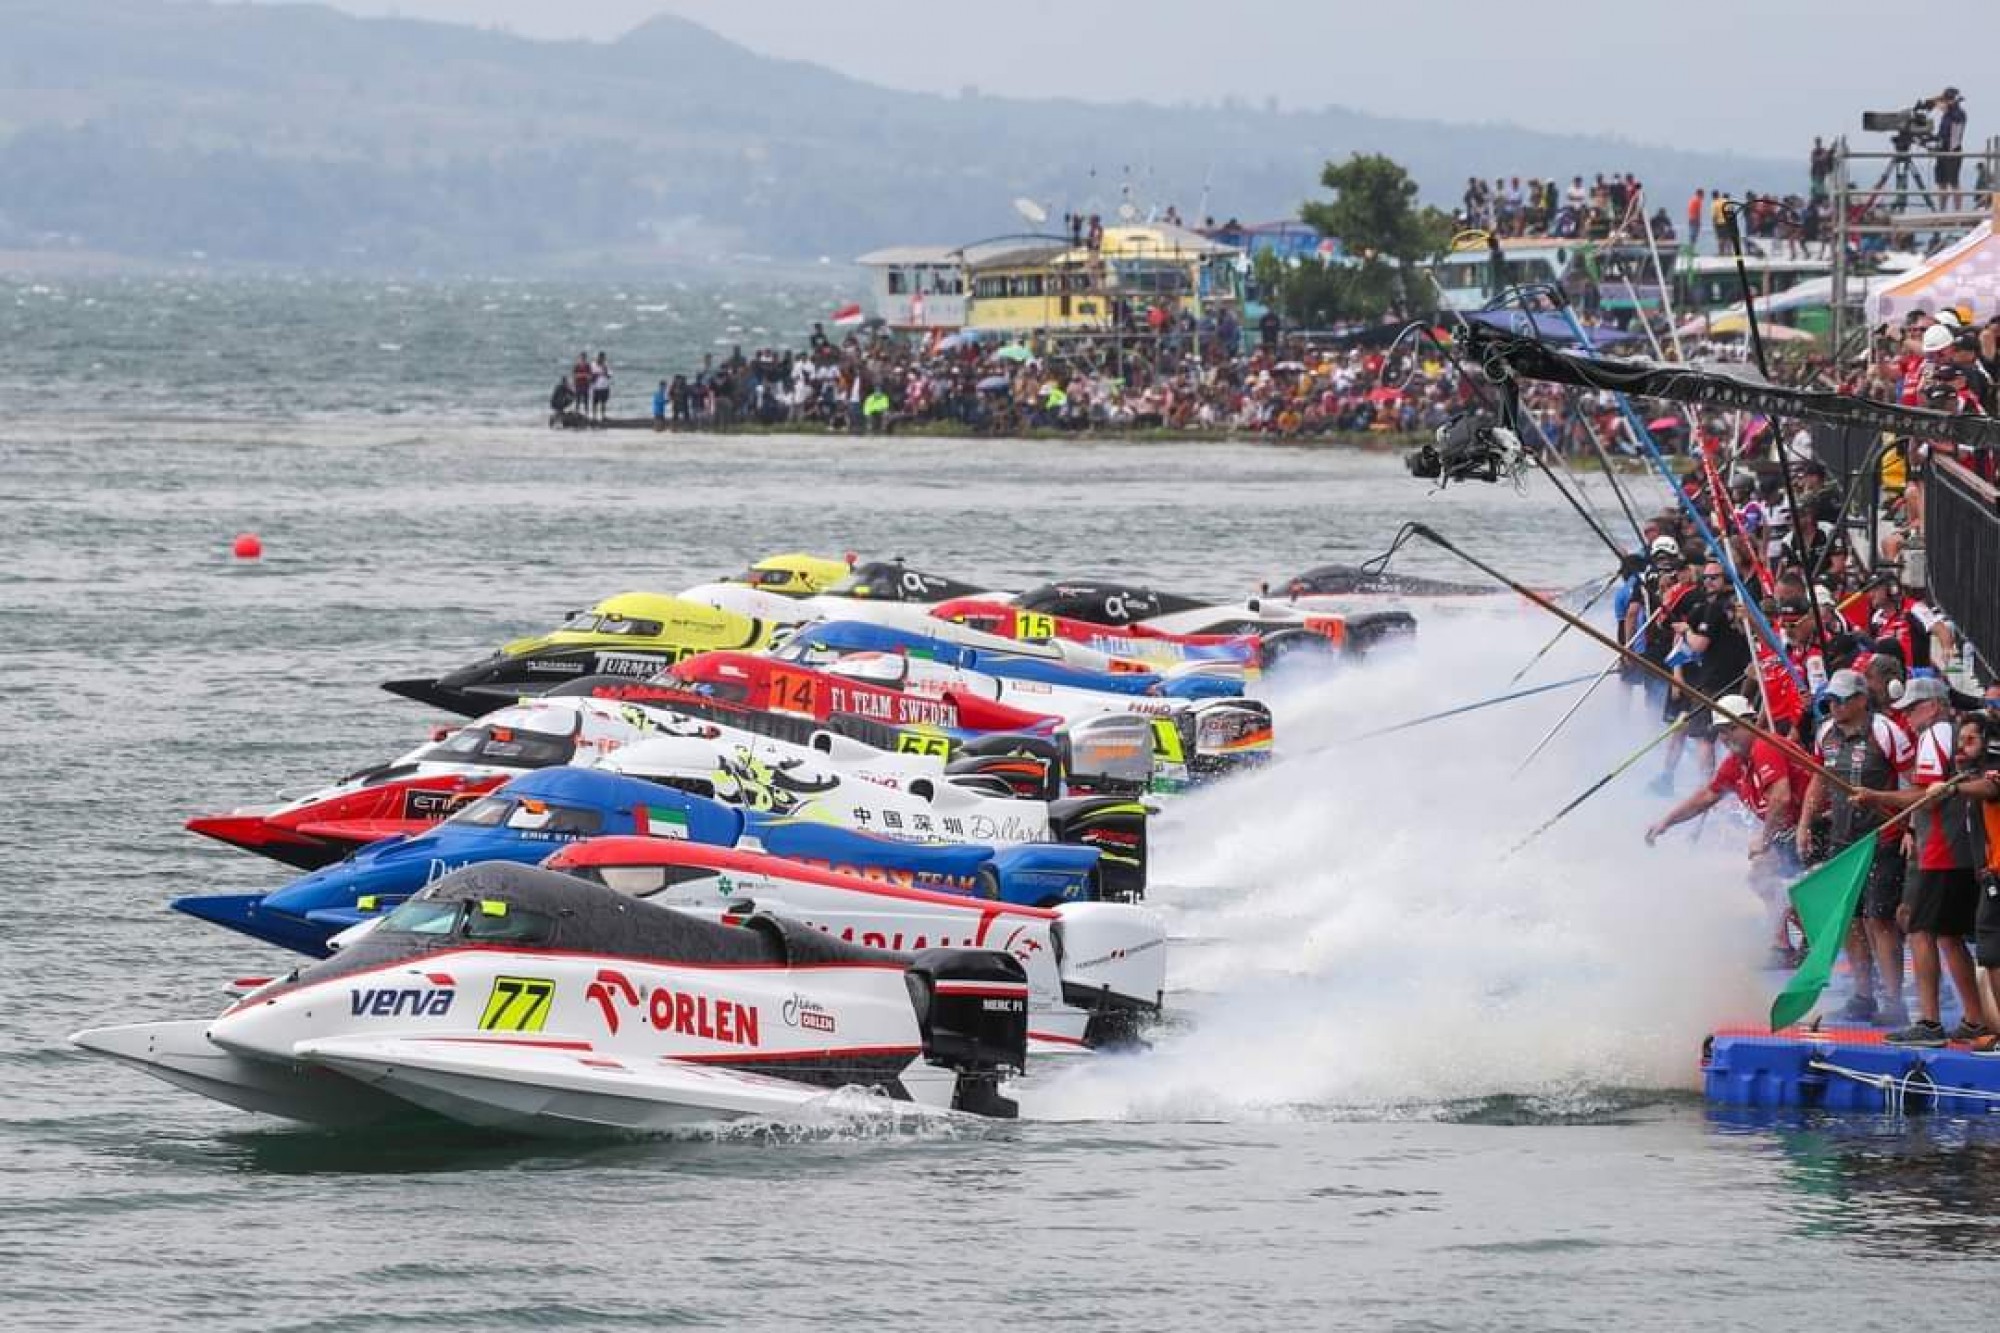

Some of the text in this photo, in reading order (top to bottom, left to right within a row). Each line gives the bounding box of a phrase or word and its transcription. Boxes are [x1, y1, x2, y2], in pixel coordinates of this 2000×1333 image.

[1019, 615, 1051, 638] 15
[774, 675, 813, 711] 14
[831, 687, 958, 727] F1 TEAM SWEDEN
[918, 871, 976, 890] TEAM
[351, 989, 455, 1016] verva
[486, 982, 551, 1031] 77
[650, 988, 759, 1047] ORLEN
